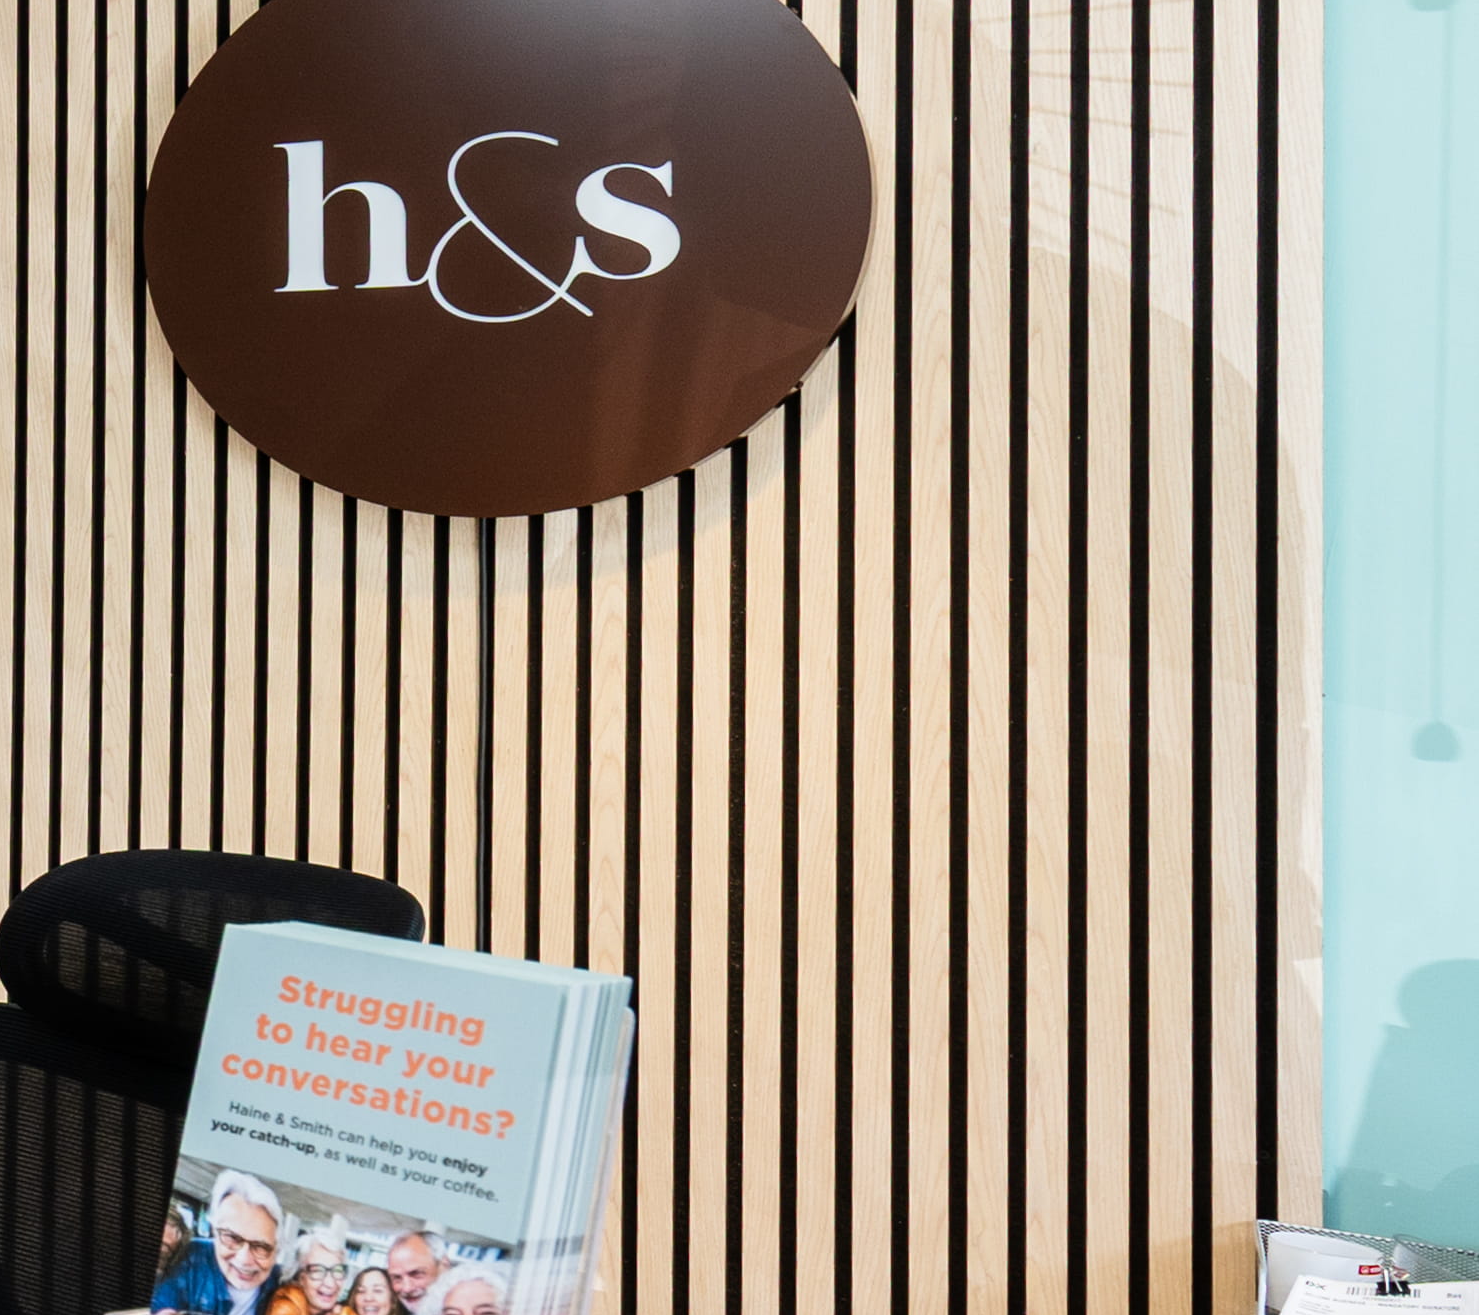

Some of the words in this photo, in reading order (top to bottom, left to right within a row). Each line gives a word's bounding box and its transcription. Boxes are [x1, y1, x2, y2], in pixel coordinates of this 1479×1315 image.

[273, 131, 681, 323] h&s
[256, 1013, 293, 1044] to
[305, 1023, 391, 1065] hear
[402, 1049, 495, 1088] your
[278, 975, 485, 1046] Struggling
[221, 1053, 516, 1139] conversations?
[211, 1119, 246, 1136] your
[249, 1127, 319, 1159] catch-up,
[323, 1147, 341, 1160] as
[345, 1152, 377, 1171] well
[380, 1162, 398, 1176] as
[402, 1167, 439, 1188] your
[443, 1175, 500, 1204] coffee.
[229, 1101, 271, 1124] Haine
[275, 1113, 286, 1126] &
[290, 1115, 335, 1138] Smith
[337, 1129, 366, 1146] can
[369, 1135, 403, 1157] help
[408, 1146, 438, 1165] you
[441, 1156, 488, 1178] enjoy
